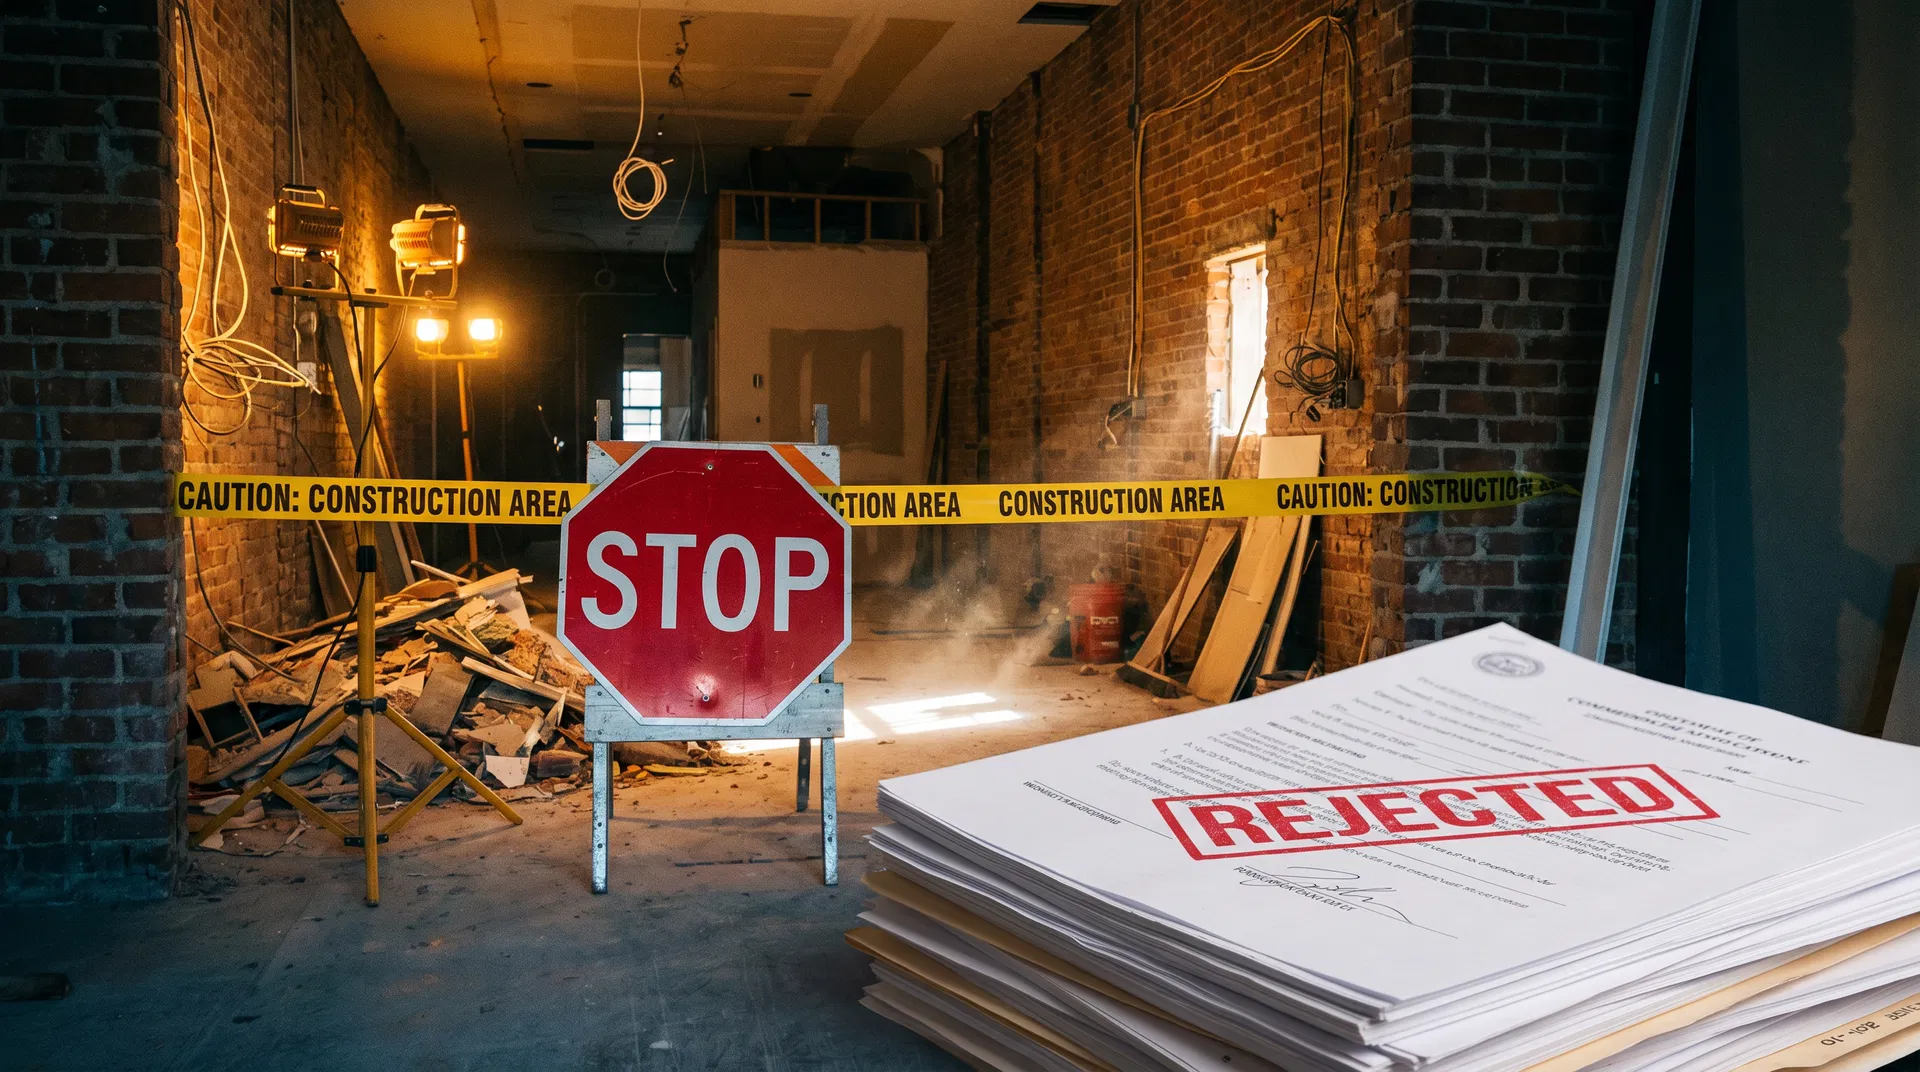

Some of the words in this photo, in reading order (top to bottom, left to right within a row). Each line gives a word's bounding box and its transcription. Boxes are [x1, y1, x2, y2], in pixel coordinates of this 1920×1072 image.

[178, 480, 299, 513] CAUTION:
[308, 484, 501, 517] CONSTRUCTION
[508, 489, 572, 517] AREA
[904, 491, 962, 518] AREA
[998, 488, 1163, 517] CONSTRUCTION
[1170, 486, 1226, 513] AREA
[1276, 483, 1373, 510] CAUTION:
[581, 530, 830, 633] STOP
[1188, 776, 1675, 848] REJECTED
